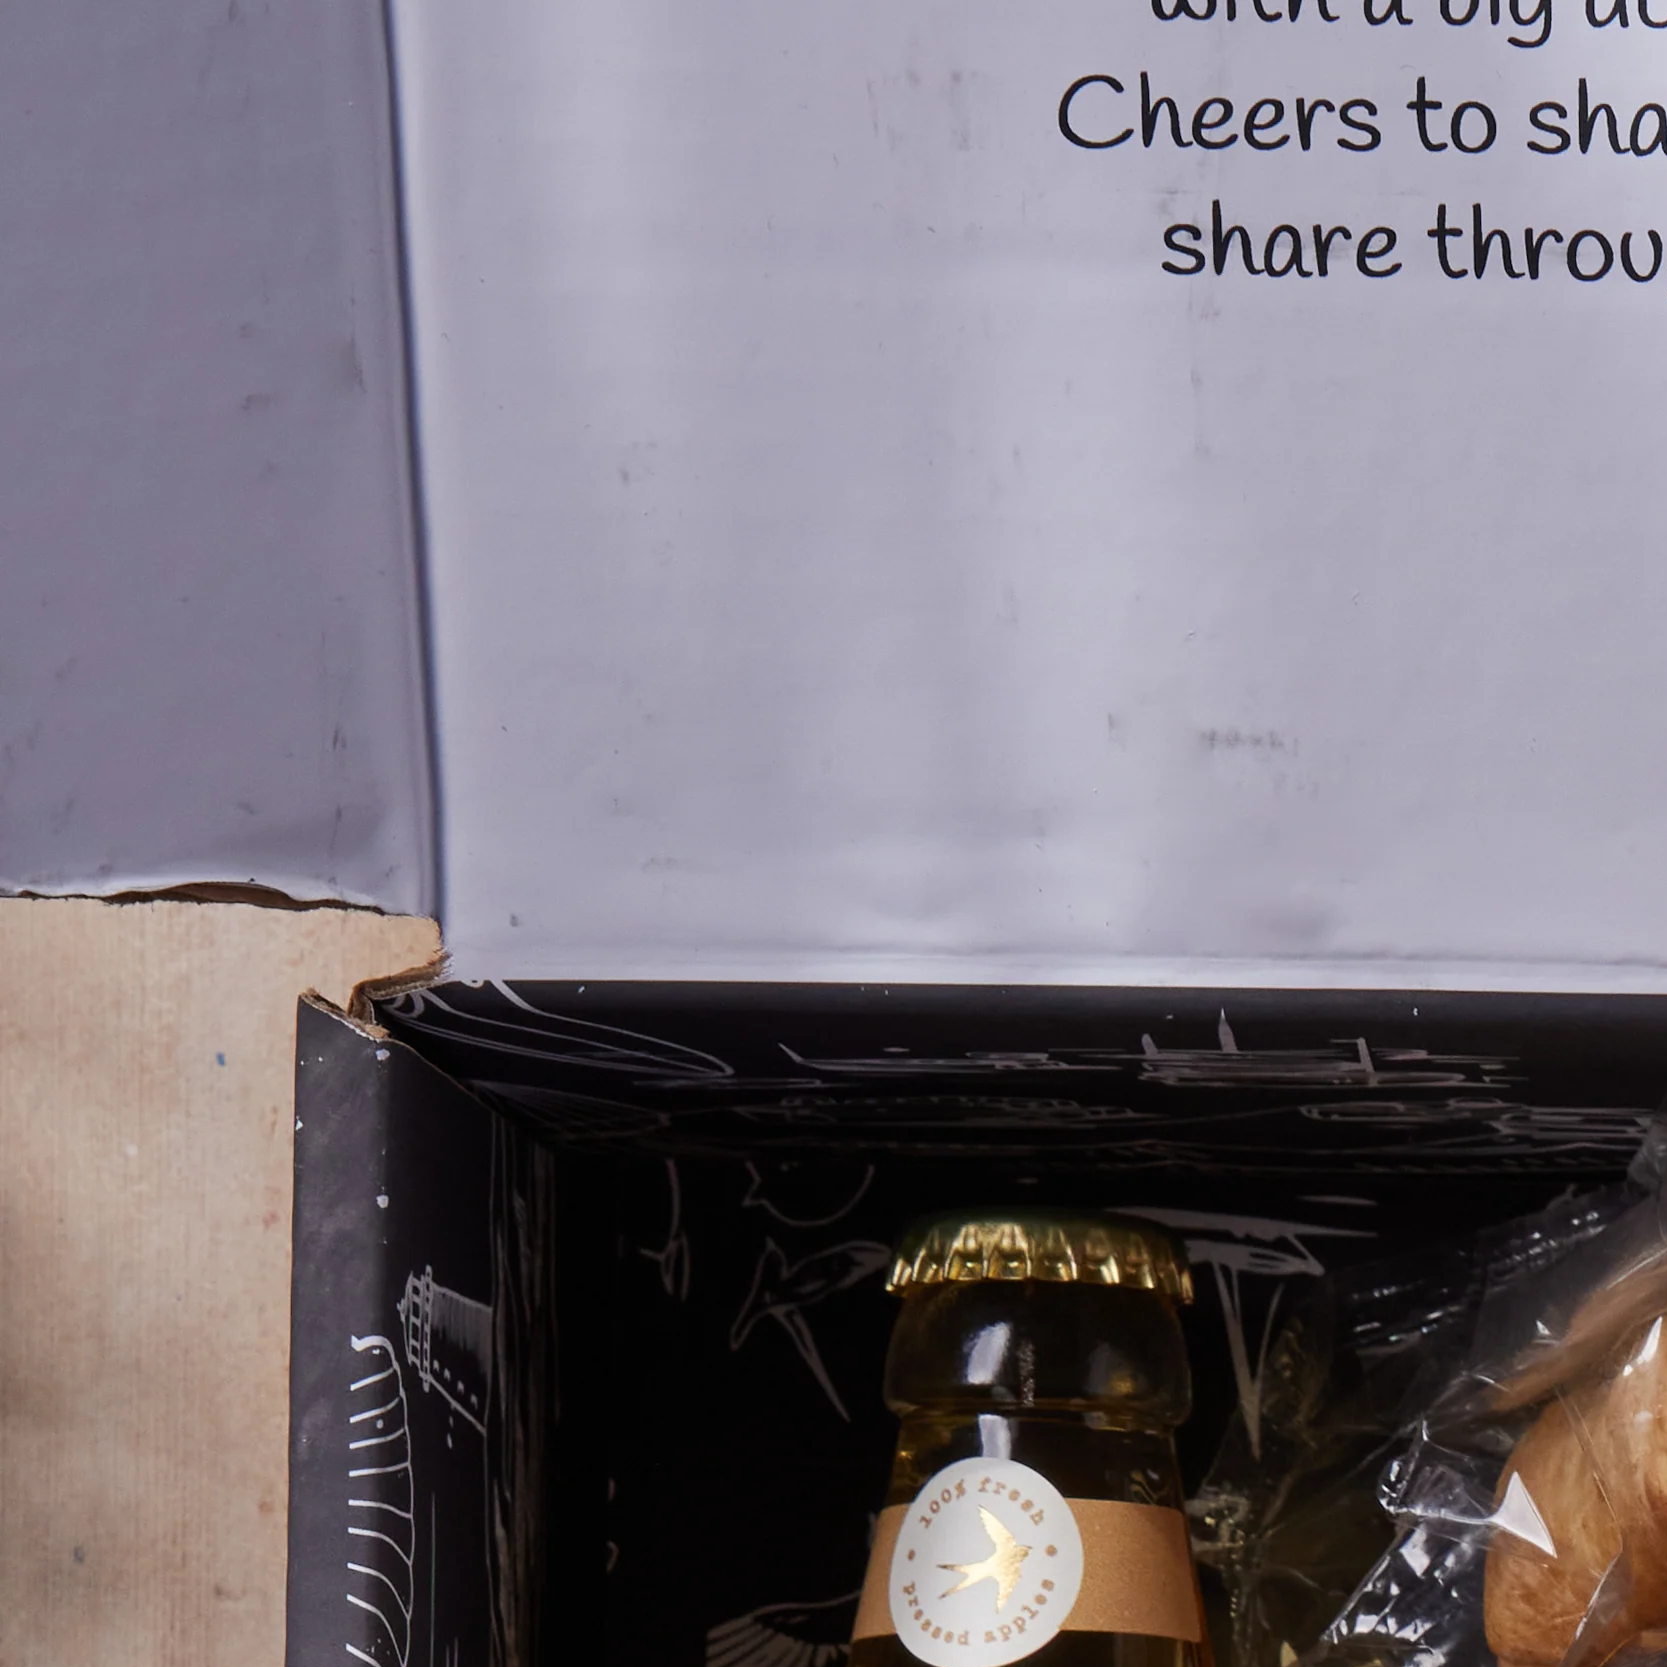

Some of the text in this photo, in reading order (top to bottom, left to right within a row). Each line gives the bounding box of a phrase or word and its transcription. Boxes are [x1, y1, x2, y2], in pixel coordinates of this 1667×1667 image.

[1059, 72, 1381, 151] Cheers
[1407, 77, 1496, 153] to
[1162, 200, 1402, 277] share
[978, 1477, 1045, 1526] fresh
[903, 1579, 1055, 1645] pressed apples
